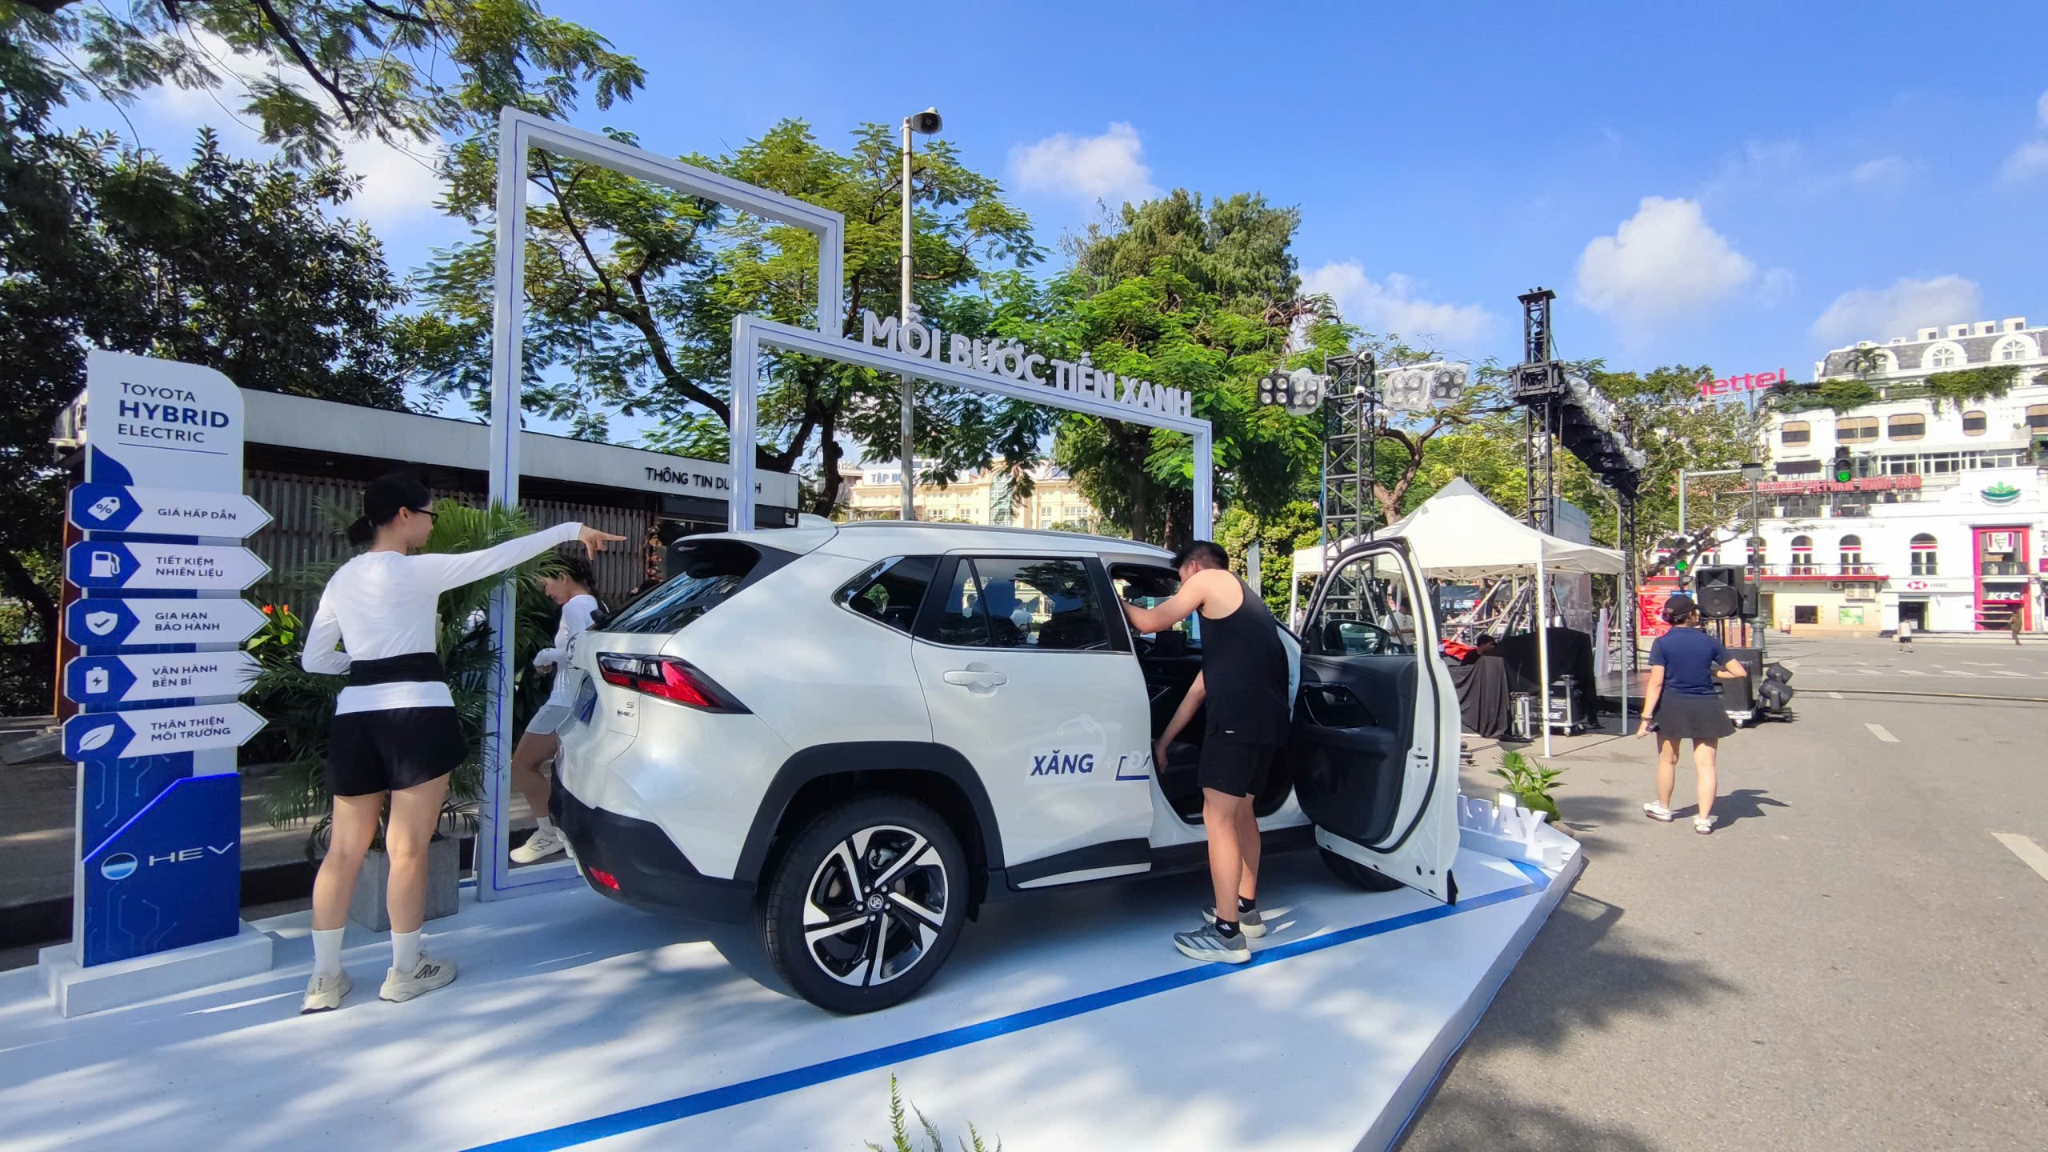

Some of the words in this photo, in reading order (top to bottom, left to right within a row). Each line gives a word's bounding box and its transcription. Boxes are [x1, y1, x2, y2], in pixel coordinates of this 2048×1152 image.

[863, 302, 941, 363] MỖI
[950, 333, 1047, 386] BƯỚC
[1050, 351, 1116, 401] TIẾN
[1120, 374, 1192, 418] XANH
[120, 382, 196, 403] TOYOTA
[119, 399, 229, 428] HYBRID
[118, 423, 205, 443] ELECTRIC
[645, 466, 689, 485] THÔNG
[692, 474, 713, 488] TIN
[157, 507, 181, 517] GIÁ
[183, 508, 208, 519] HẤP
[156, 555, 182, 565] TIẾT
[184, 556, 214, 568] KIỆM
[155, 567, 195, 577] NHIÊN
[198, 568, 223, 579] LIỆU
[1987, 592, 2021, 601] KFC
[155, 612, 178, 620] GIA
[181, 612, 208, 622] HẠN
[155, 621, 182, 631] BẢO
[185, 621, 220, 631] HÀNH
[152, 665, 179, 676] VẬN
[182, 664, 218, 674] HÀNH
[152, 676, 177, 688] BỀN
[151, 719, 186, 731] THÂN
[189, 716, 225, 728] THIỆN
[151, 731, 177, 742] MÔI
[179, 727, 231, 739] TRƯỜNG
[1030, 749, 1094, 776] XĂNG
[149, 841, 235, 867] HEV
